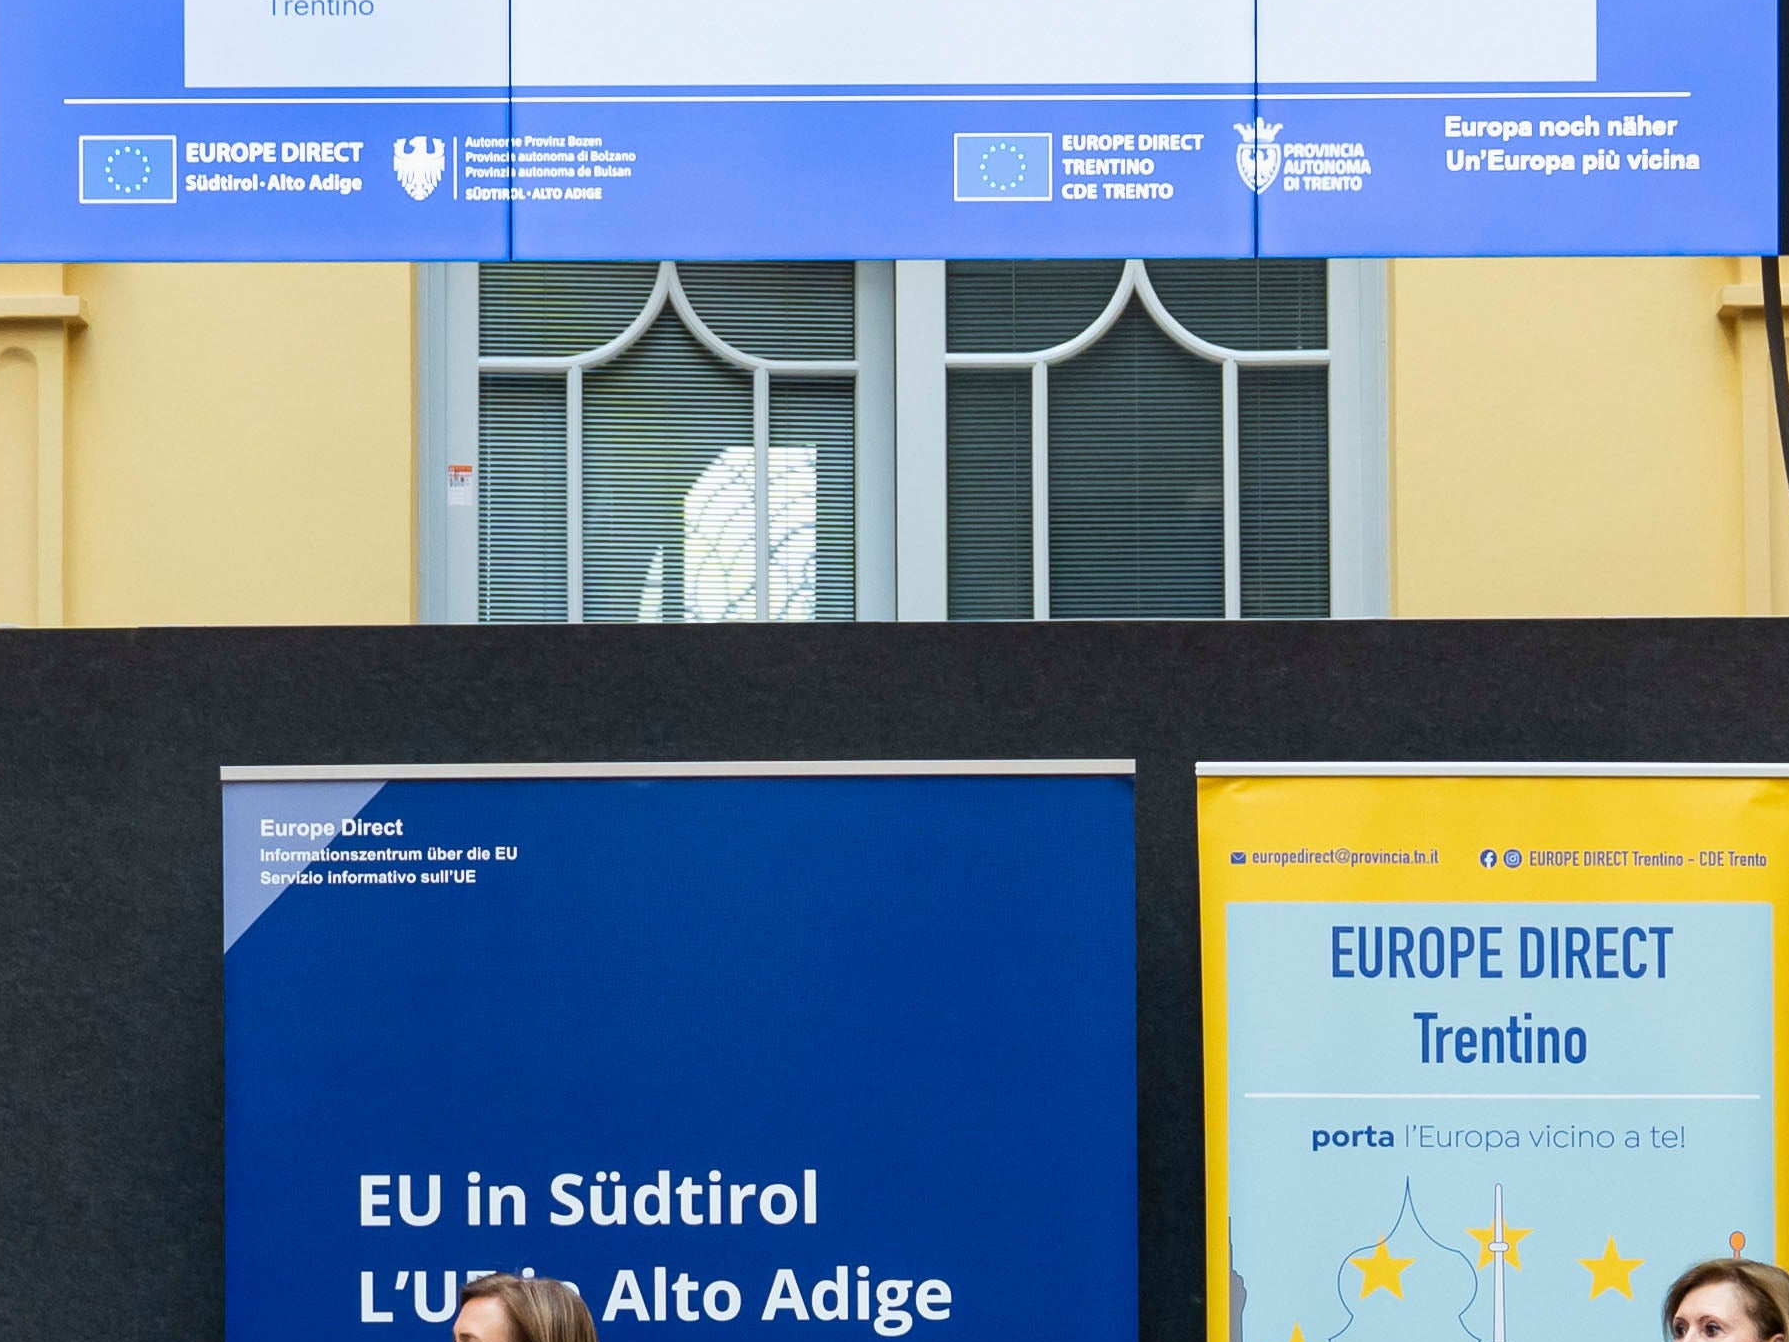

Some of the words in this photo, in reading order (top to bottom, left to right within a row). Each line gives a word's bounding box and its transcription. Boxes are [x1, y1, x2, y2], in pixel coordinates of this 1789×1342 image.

[1445, 116, 1532, 142] Europa
[1539, 115, 1598, 136] noch
[1607, 115, 1677, 136] näher
[465, 136, 522, 148] Autonome
[525, 136, 565, 147] Provinz
[568, 135, 602, 147] Bozen
[1062, 133, 1132, 151] EUROPE
[1138, 133, 1203, 151] DIRECT
[1284, 143, 1364, 157] PROVINCIA
[186, 142, 277, 163] EUROPE
[282, 141, 363, 163] DIRECT
[518, 152, 574, 162] autonoma
[577, 151, 588, 161] di
[591, 151, 636, 162] Bolzano
[1062, 158, 1154, 176] TRENTINO
[1284, 159, 1371, 174] AUTONOMA
[1447, 149, 1577, 175] Un’Europa
[1583, 148, 1621, 175] più
[1628, 149, 1700, 170] vicina
[518, 167, 574, 177] autonoma
[577, 165, 591, 177] de
[594, 165, 631, 177] Bulsan
[310, 174, 362, 196] Adige
[1062, 183, 1095, 199] CDE
[1102, 182, 1174, 199] TRENTO
[1284, 176, 1299, 191] DI
[1303, 176, 1362, 191] TRENTO
[565, 187, 602, 199] ADIGE
[260, 819, 335, 840] Europe
[341, 818, 403, 836] Direct
[260, 848, 422, 862] Informationszentrum
[427, 847, 463, 861] über
[467, 847, 491, 860] die
[495, 846, 518, 860] EU
[1252, 848, 1439, 867] europedirect@provincia.tn.it
[1530, 851, 1580, 866] EUROPE
[1584, 851, 1628, 866] DIRECT
[1633, 851, 1683, 867] Trentino
[1699, 851, 1724, 866] CDE
[1728, 852, 1767, 867] Trento
[260, 870, 323, 885] Servizio
[328, 870, 416, 884] informativo
[421, 869, 476, 883] sull’UE
[1332, 926, 1503, 978] EUROPE
[1520, 926, 1673, 979] DIRECT
[1413, 1012, 1588, 1064] Trentino
[1312, 1127, 1394, 1151] porta
[1405, 1124, 1520, 1151] l’Europa
[1528, 1126, 1615, 1148] vicino
[1624, 1131, 1640, 1148] a
[1649, 1125, 1685, 1148] te!
[359, 1174, 442, 1226] EU
[467, 1171, 527, 1226] in
[549, 1169, 817, 1226] Südtirol
[360, 1270, 498, 1323] L’U
[603, 1268, 742, 1321] Alto
[762, 1265, 952, 1336] Adige
